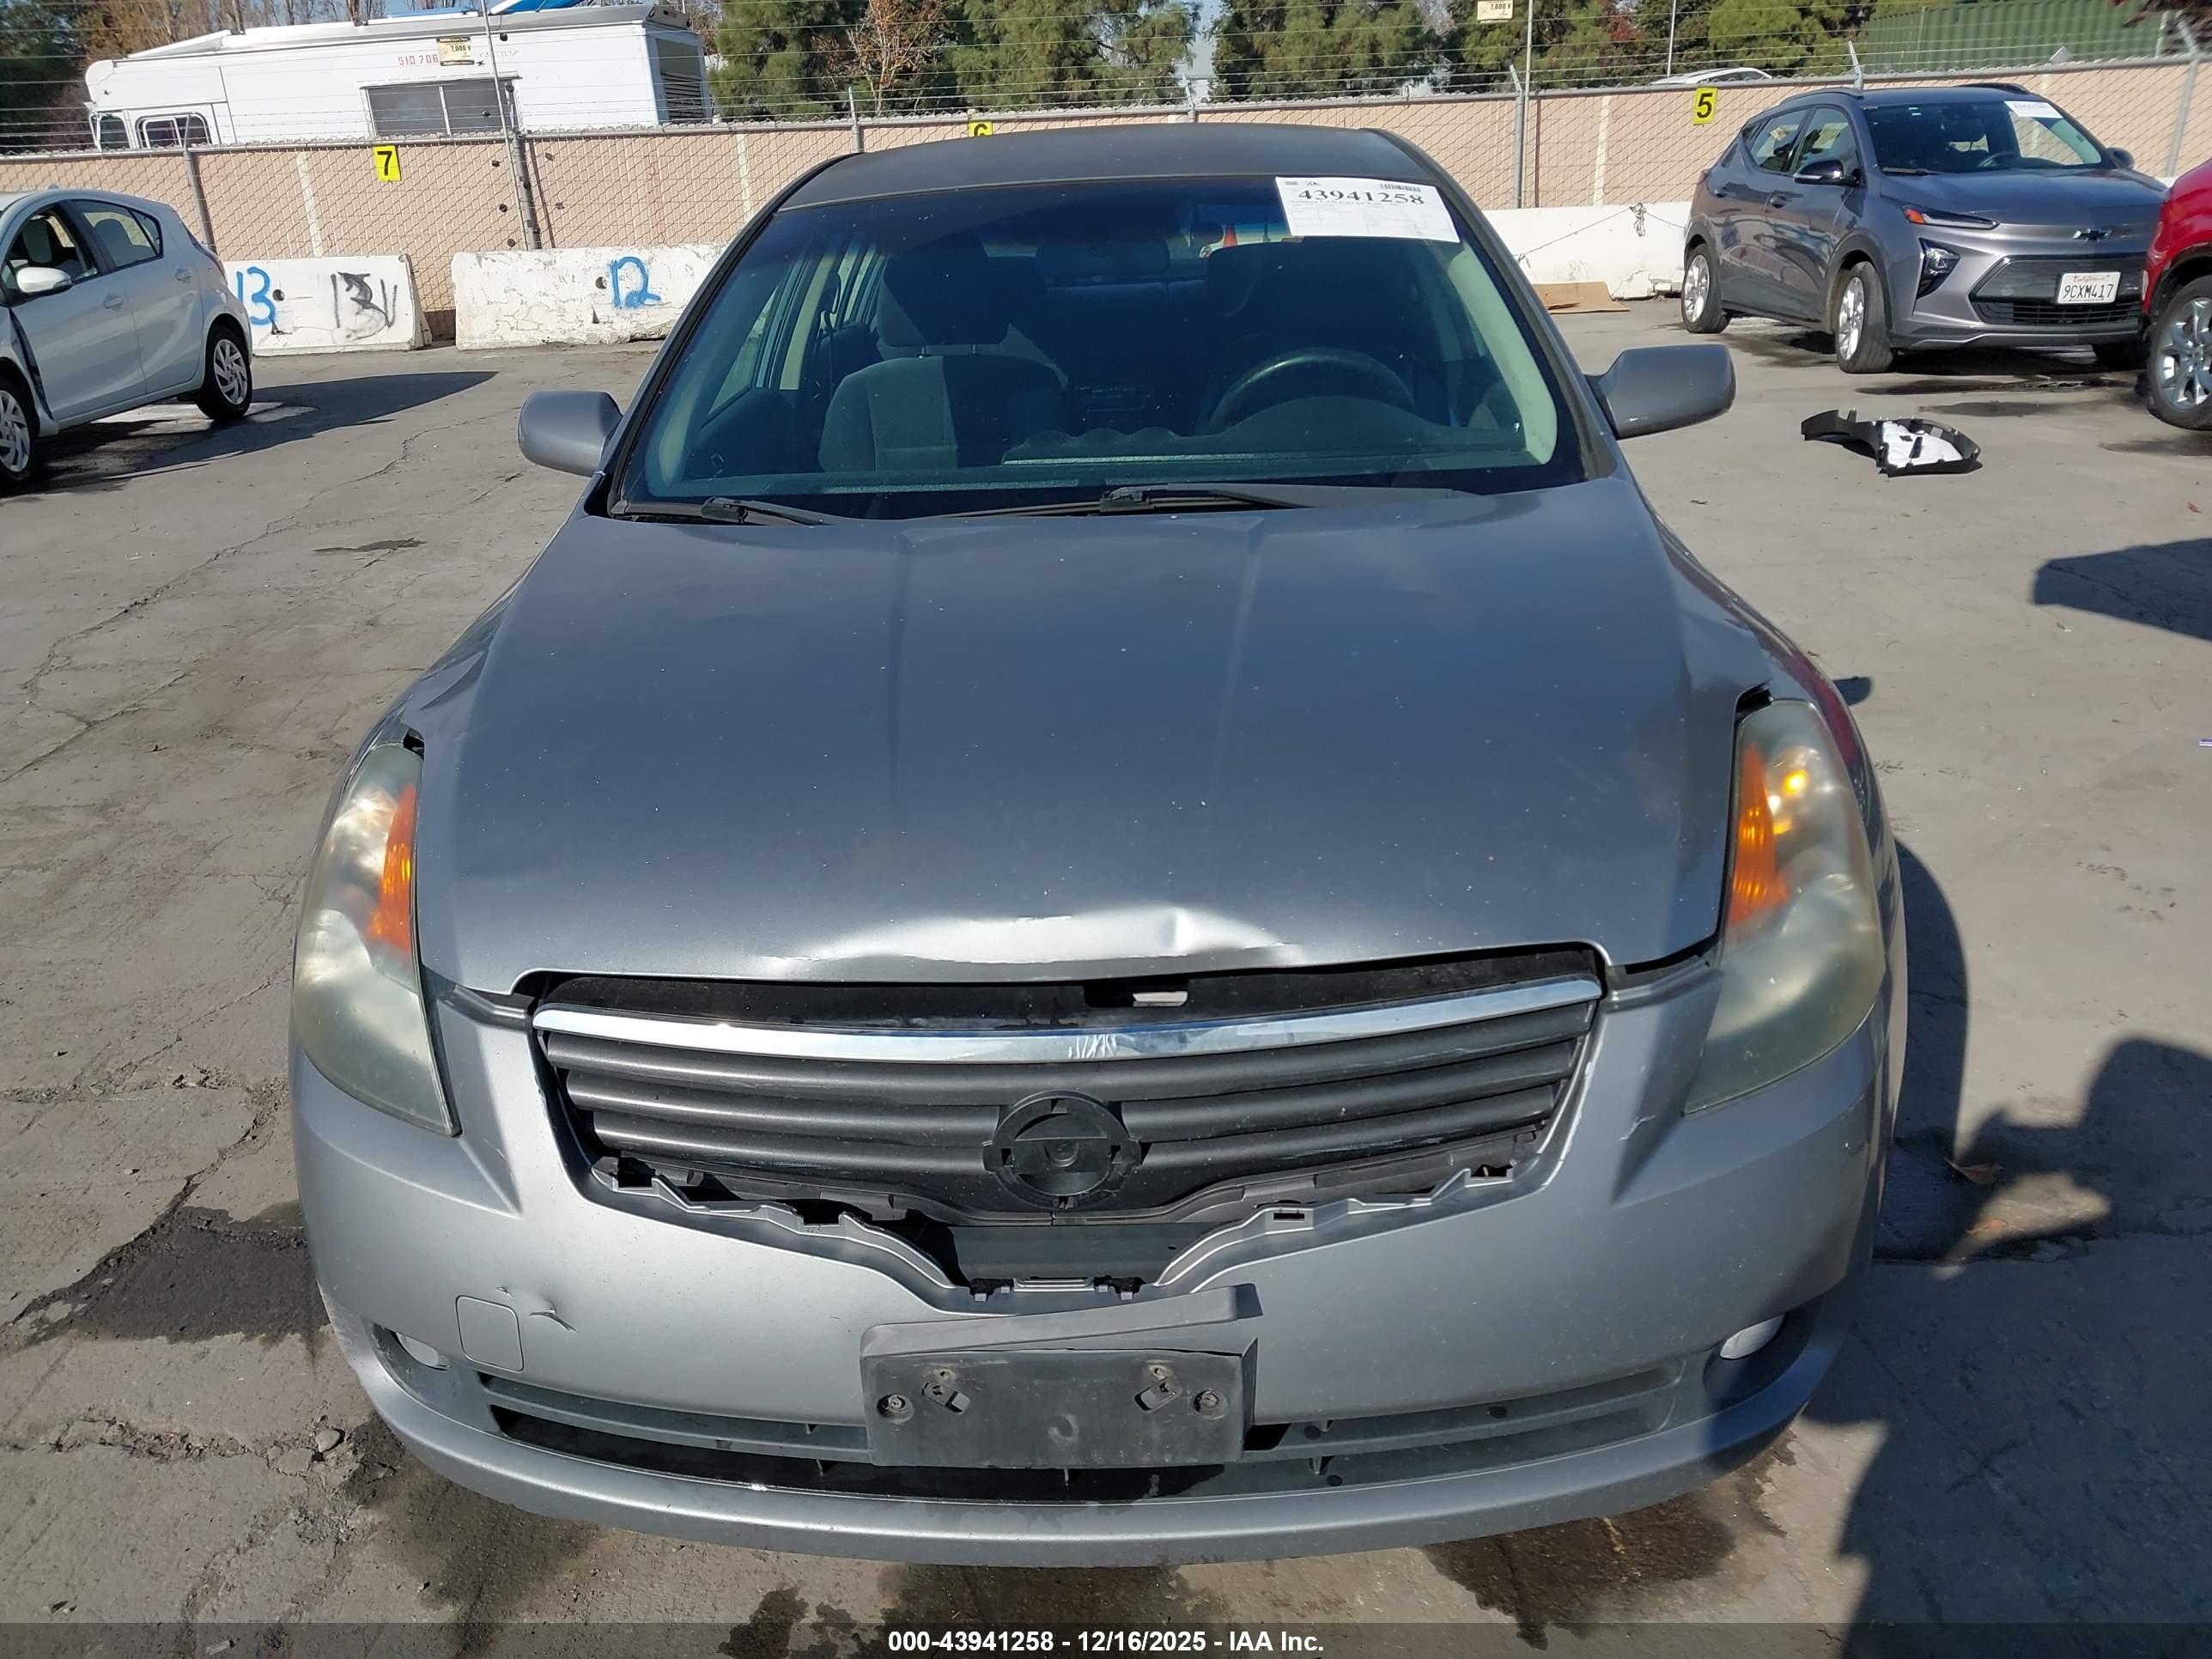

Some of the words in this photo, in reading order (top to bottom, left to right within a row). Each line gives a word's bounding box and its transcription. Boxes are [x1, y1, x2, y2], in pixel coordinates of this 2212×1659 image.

[398, 55, 416, 66] 510
[1697, 92, 1714, 118] 5
[376, 150, 392, 176] 7
[1297, 189, 1425, 206] 43941258
[610, 256, 662, 308] 12
[2063, 283, 2114, 300] 9CXM417
[236, 265, 276, 326] 13
